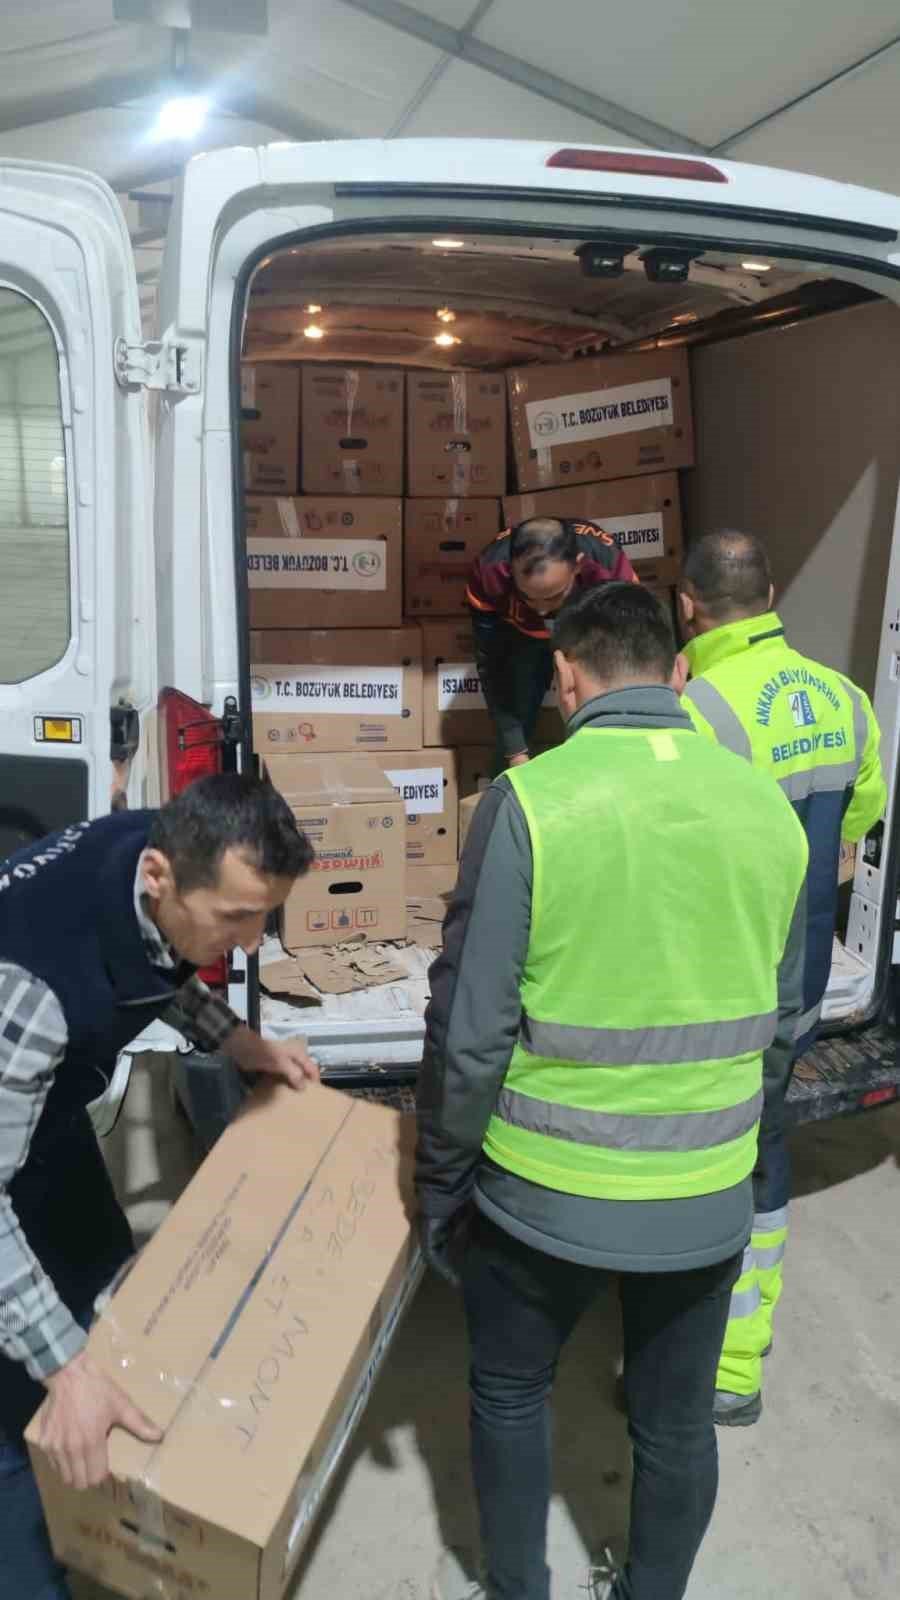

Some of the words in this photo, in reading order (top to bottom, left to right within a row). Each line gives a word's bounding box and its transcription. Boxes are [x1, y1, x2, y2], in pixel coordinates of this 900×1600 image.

[561, 412, 578, 429] T.C.
[579, 402, 621, 426] BOZÜYÜK
[621, 395, 668, 417] BELEDİYESİ
[282, 554, 328, 573] BOZÜYÜK
[332, 554, 349, 572] T.C.
[275, 680, 293, 697] T.C.
[295, 681, 341, 698] BOZÜYÜK
[343, 682, 398, 699] BELEDİYESİ
[756, 677, 781, 727] ANKARA
[771, 726, 847, 763] BELEDİYESİ
